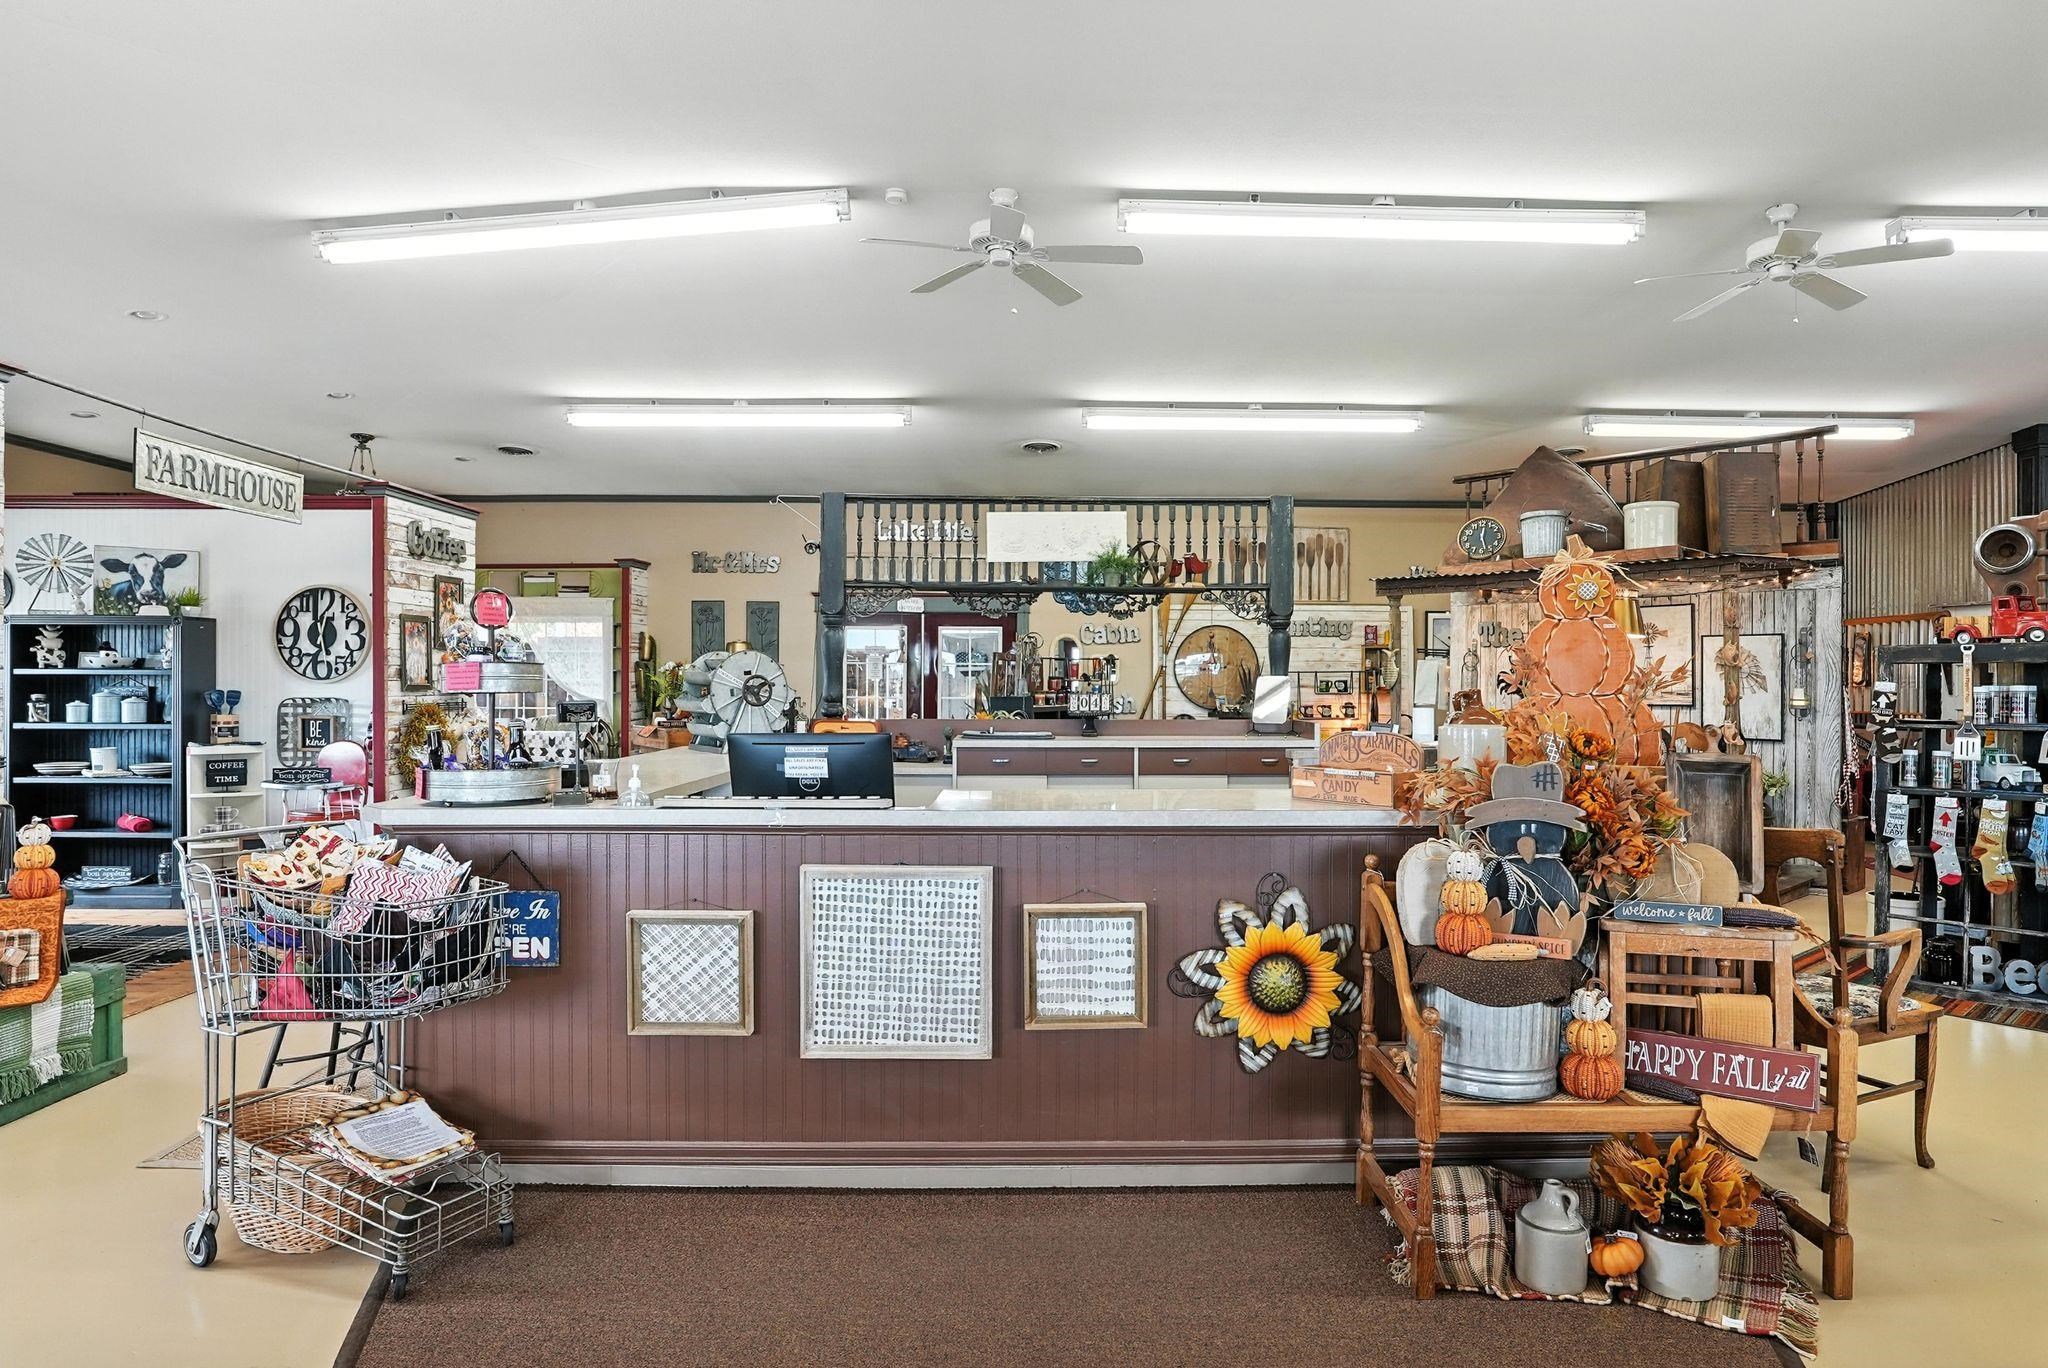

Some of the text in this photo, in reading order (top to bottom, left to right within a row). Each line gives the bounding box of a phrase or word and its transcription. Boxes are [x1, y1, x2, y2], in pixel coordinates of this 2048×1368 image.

[145, 443, 297, 513] FARMHOUSE
[877, 519, 930, 541] Lake
[407, 520, 467, 563] Coffee
[692, 551, 781, 573] Mr & Mrs
[311, 589, 335, 622] 12
[277, 618, 300, 649] 9
[345, 619, 366, 652] 3
[1080, 623, 1141, 645] Cabin
[1478, 621, 1523, 648] The
[288, 647, 303, 667] 8
[311, 648, 333, 680] 6
[334, 656, 348, 675] 5
[310, 720, 322, 738] BE
[306, 737, 328, 747] kind
[1358, 735, 1420, 769] CARAMELS
[209, 762, 245, 770] COFFEE
[1321, 779, 1359, 793] CANDY
[1932, 829, 1955, 838] SISTER
[524, 898, 551, 919] In
[1622, 904, 1715, 921] welcome fall
[494, 936, 550, 959] PEN
[1625, 1039, 1811, 1093] HAPPY FALL y'all
